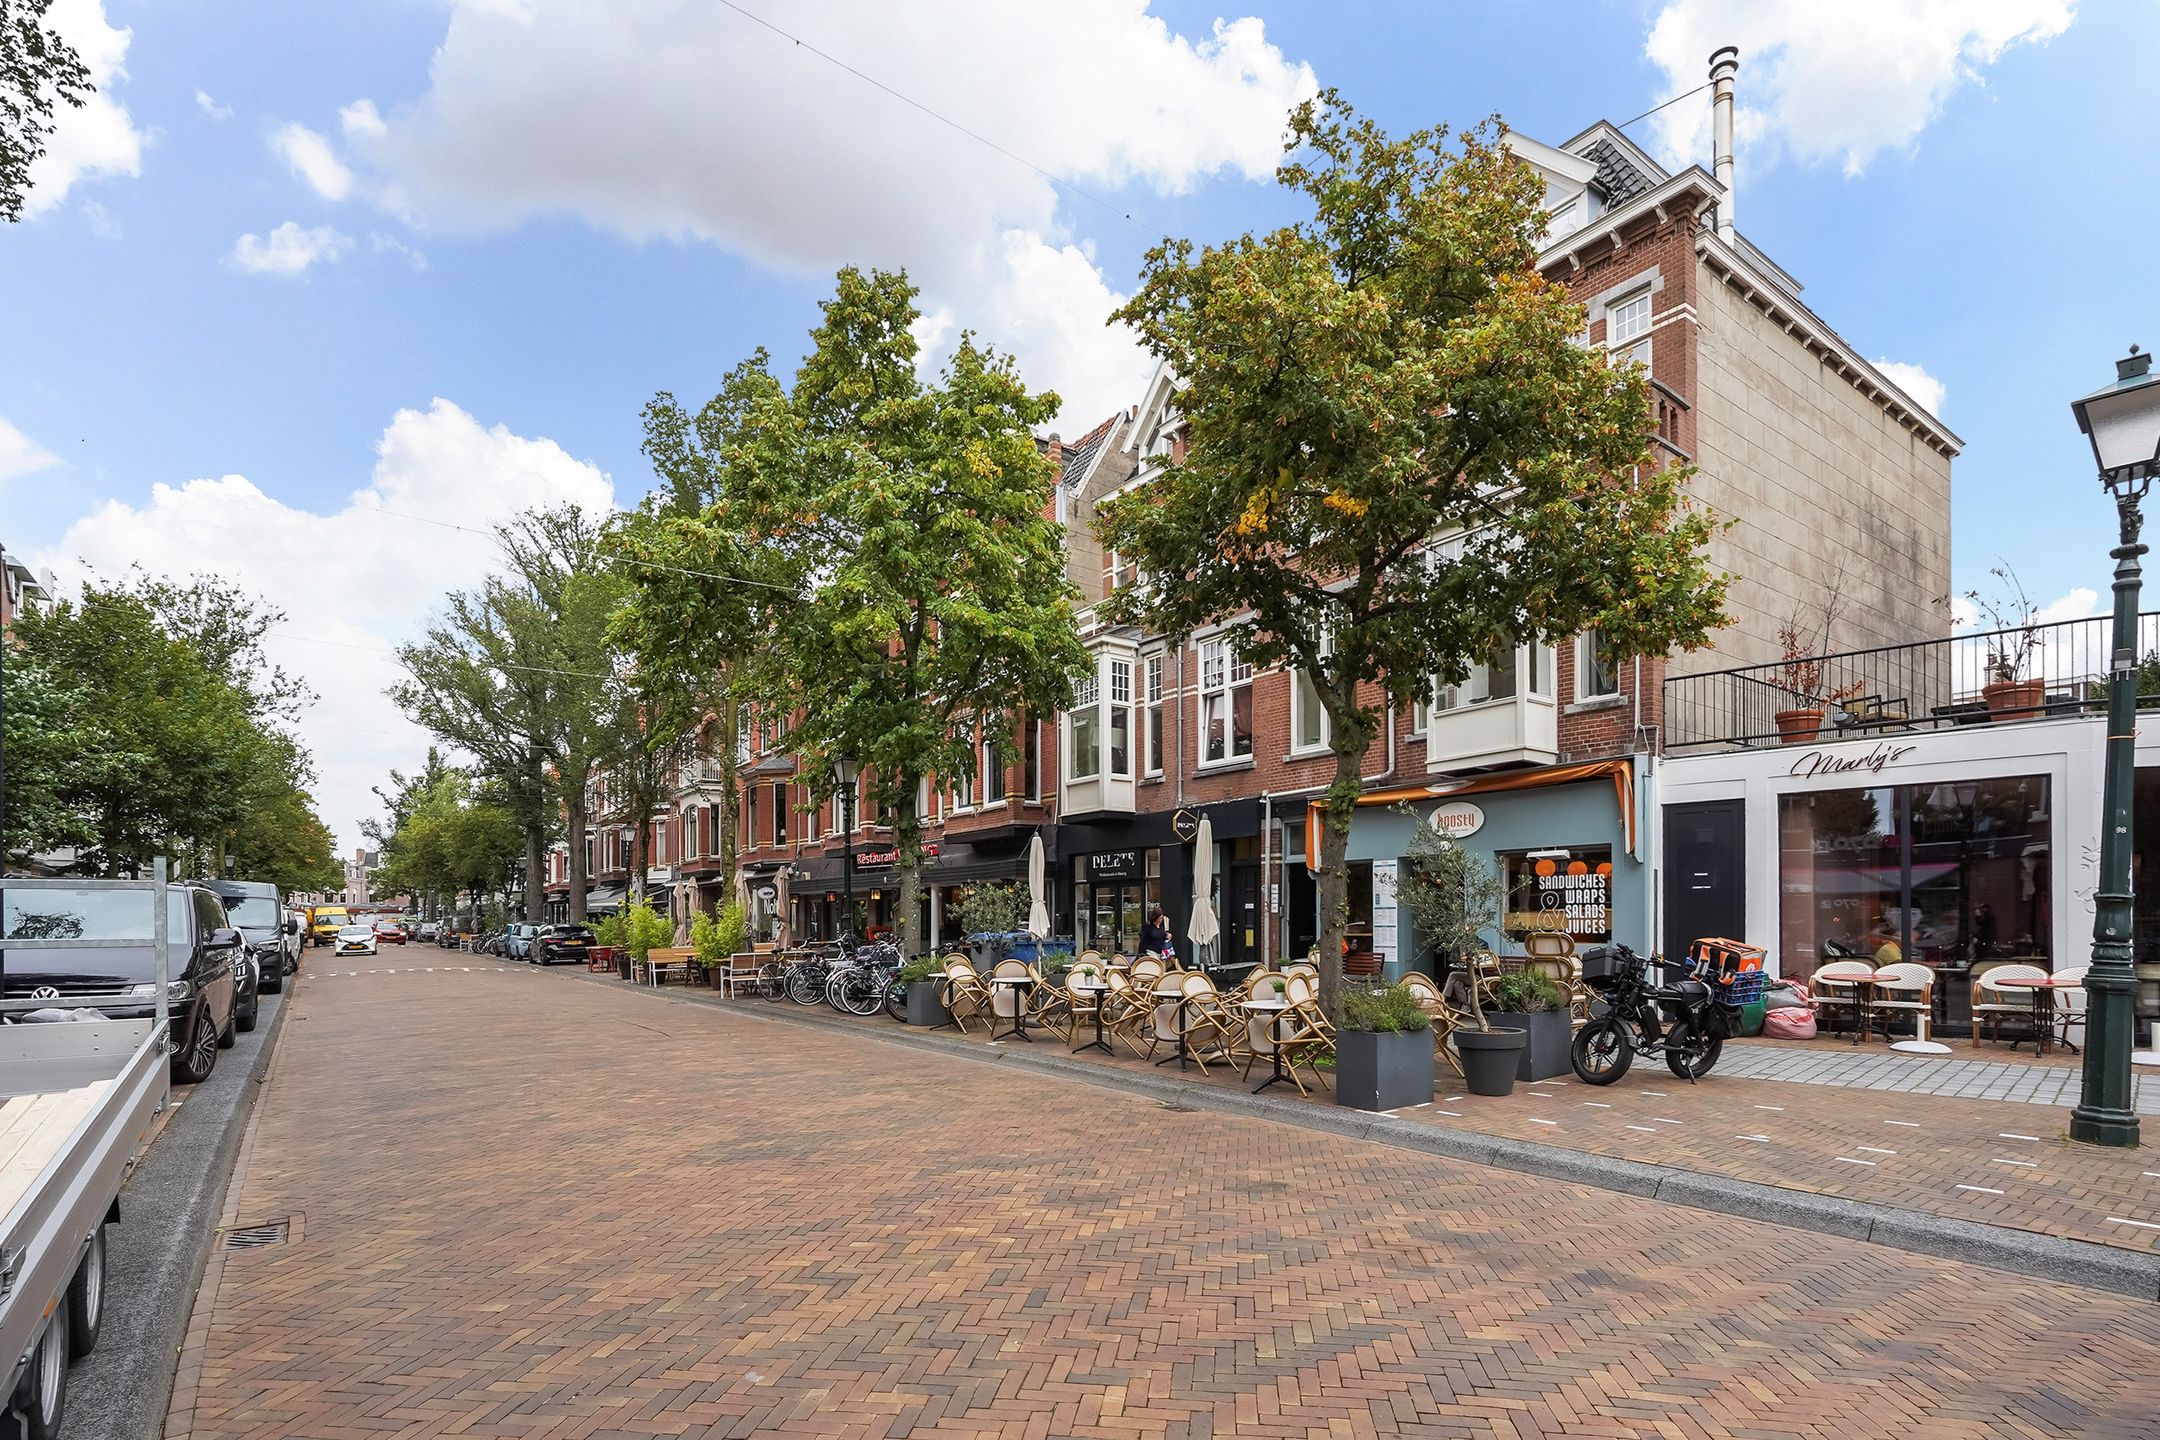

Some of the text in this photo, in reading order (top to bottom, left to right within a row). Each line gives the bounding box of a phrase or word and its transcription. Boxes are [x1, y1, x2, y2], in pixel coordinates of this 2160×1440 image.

[1790, 742, 1917, 779] Marly's
[1437, 813, 1474, 828] boosty
[2115, 826, 2127, 834] 98
[856, 851, 896, 865] Restaurant
[1539, 874, 1605, 890] SANDWICHES
[1565, 888, 1606, 904] WRAPS
[1537, 890, 1566, 934] &
[1565, 904, 1606, 919] SALADS
[1565, 919, 1606, 934] JUICES
